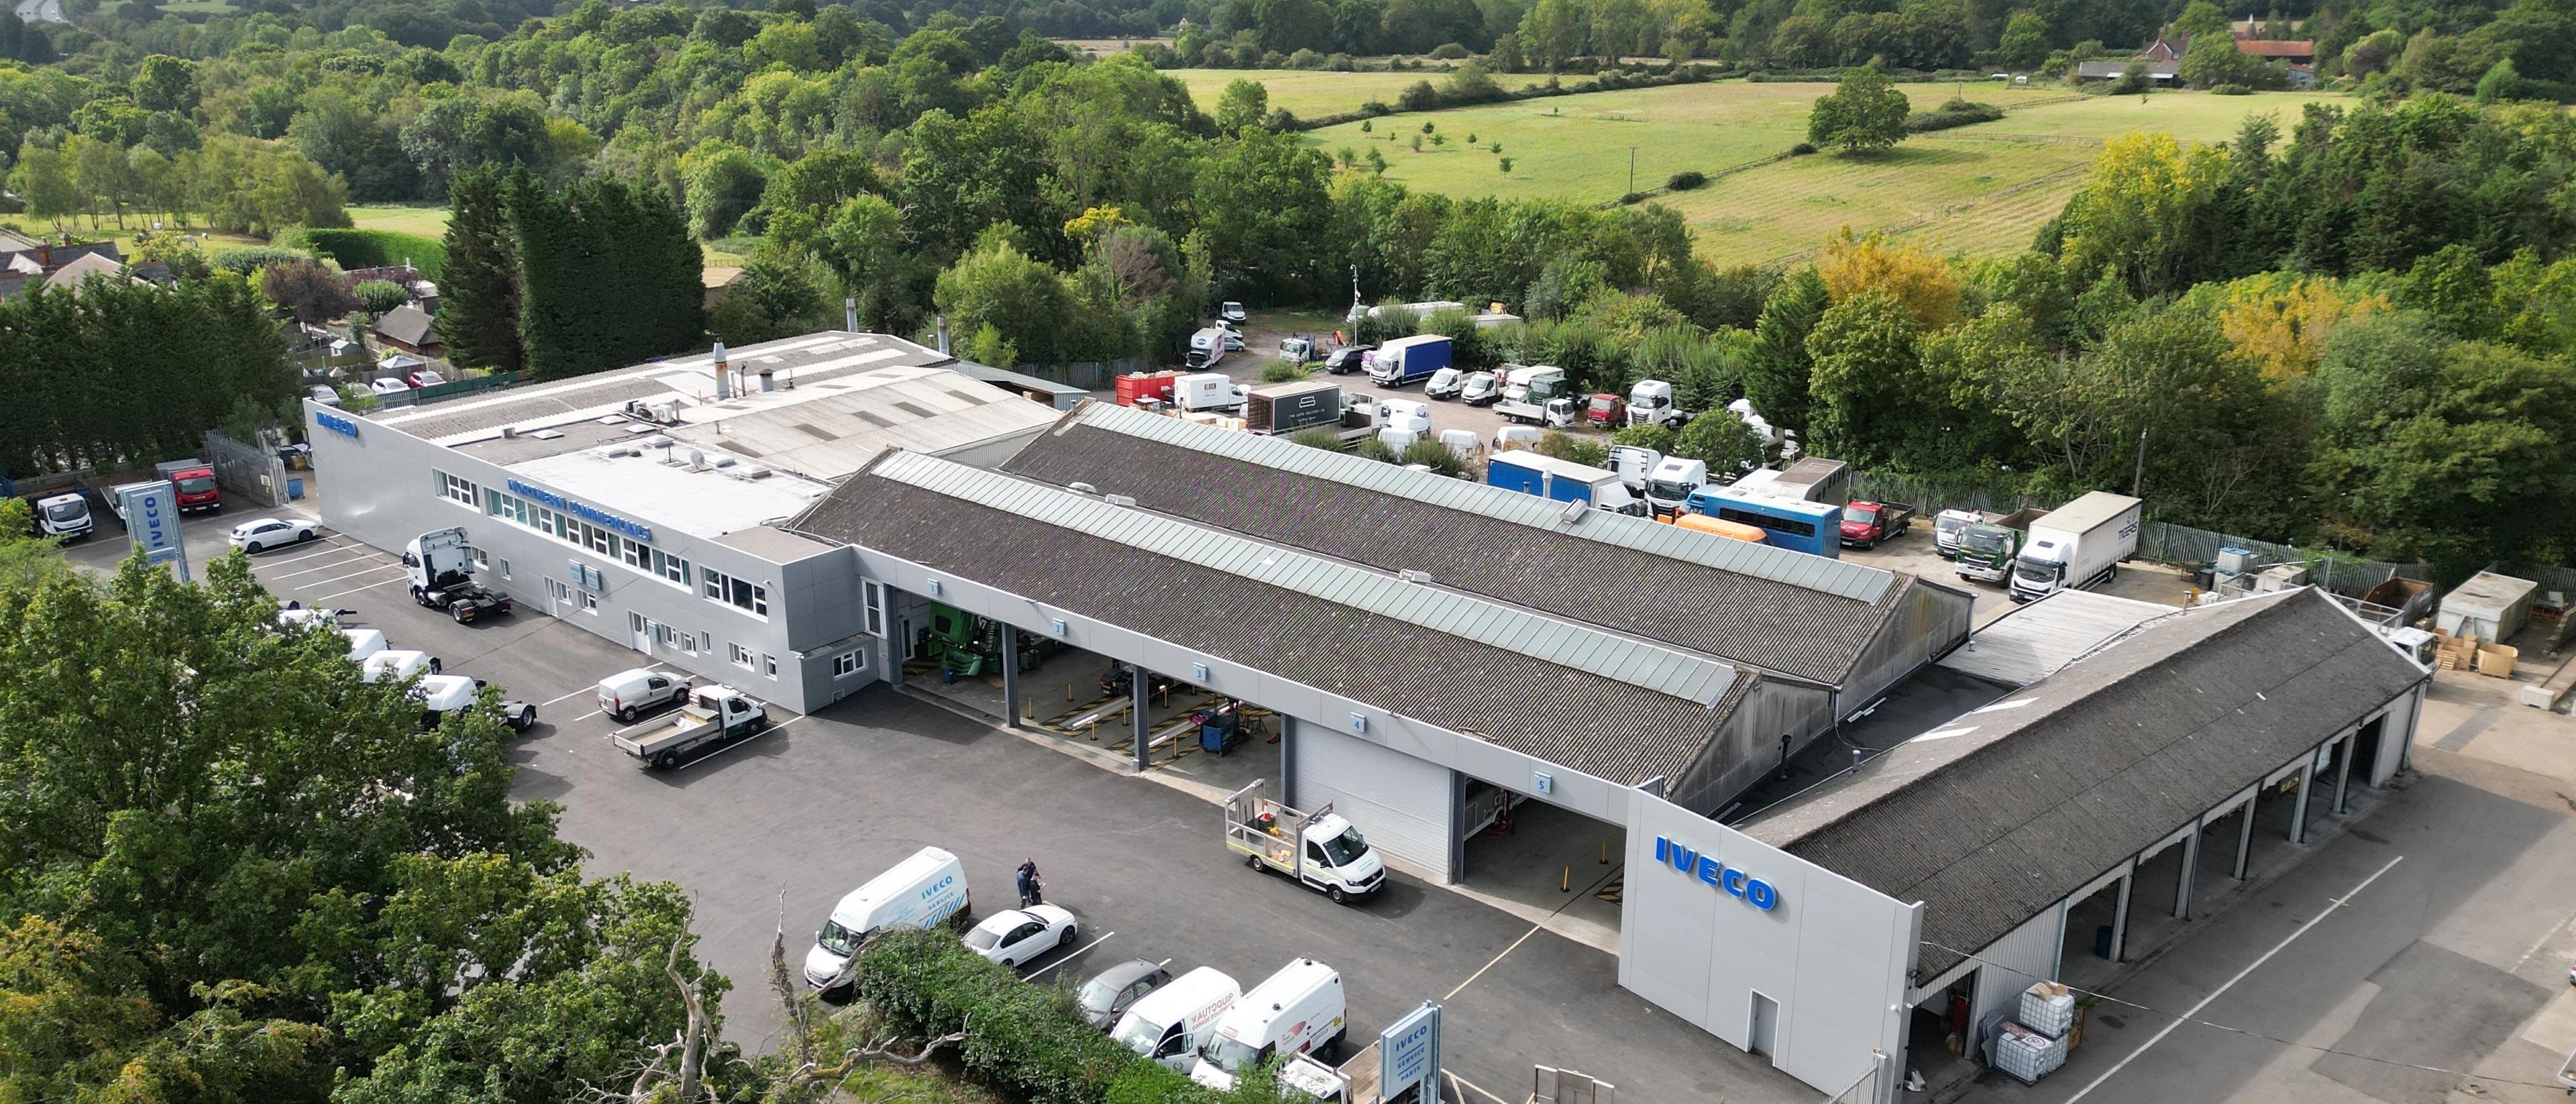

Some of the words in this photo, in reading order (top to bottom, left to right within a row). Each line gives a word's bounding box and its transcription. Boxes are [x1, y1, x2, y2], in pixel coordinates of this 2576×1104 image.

[316, 410, 358, 438] IVECO
[144, 497, 164, 548] IVECO
[1056, 625, 1060, 633] 2
[1197, 670, 1201, 678] 3
[1354, 721, 1360, 730] 4
[1539, 780, 1544, 790] 5
[1655, 834, 1777, 911] IVECO
[921, 875, 953, 900] IVECO
[928, 891, 954, 911] SERVICE
[1197, 993, 1234, 1021] AUTOQUIP
[1396, 1025, 1427, 1052] IVECO
[1397, 1047, 1425, 1070] SERVICE
[1401, 1064, 1421, 1082] PARTS
